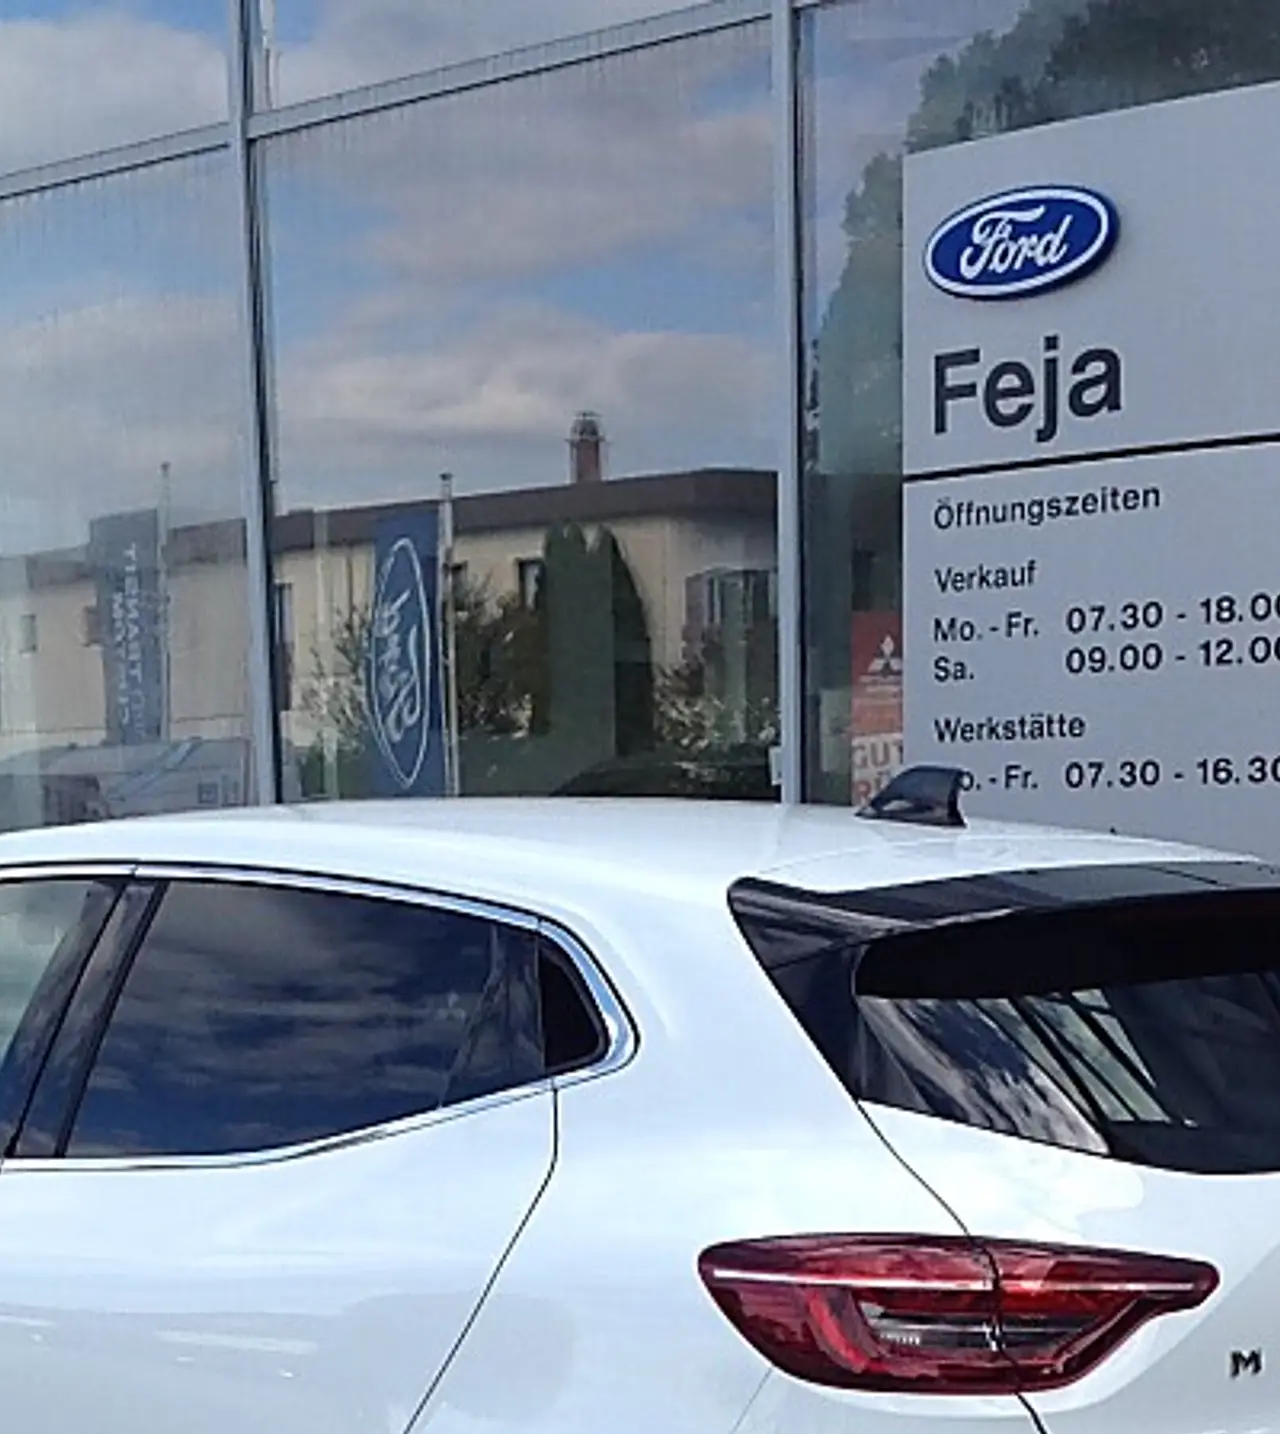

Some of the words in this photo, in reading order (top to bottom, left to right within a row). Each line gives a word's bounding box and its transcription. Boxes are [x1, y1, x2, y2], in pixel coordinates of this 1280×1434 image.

[933, 333, 1123, 443] Feja
[933, 484, 1161, 530] Öffnungszeiten
[933, 559, 1037, 593] Verkauf
[1064, 602, 1163, 634] 07.30
[933, 655, 975, 683] Sa.
[1064, 641, 1163, 675] 09.00
[933, 710, 1087, 743] Werkstätte
[1064, 760, 1161, 789] 07.30
